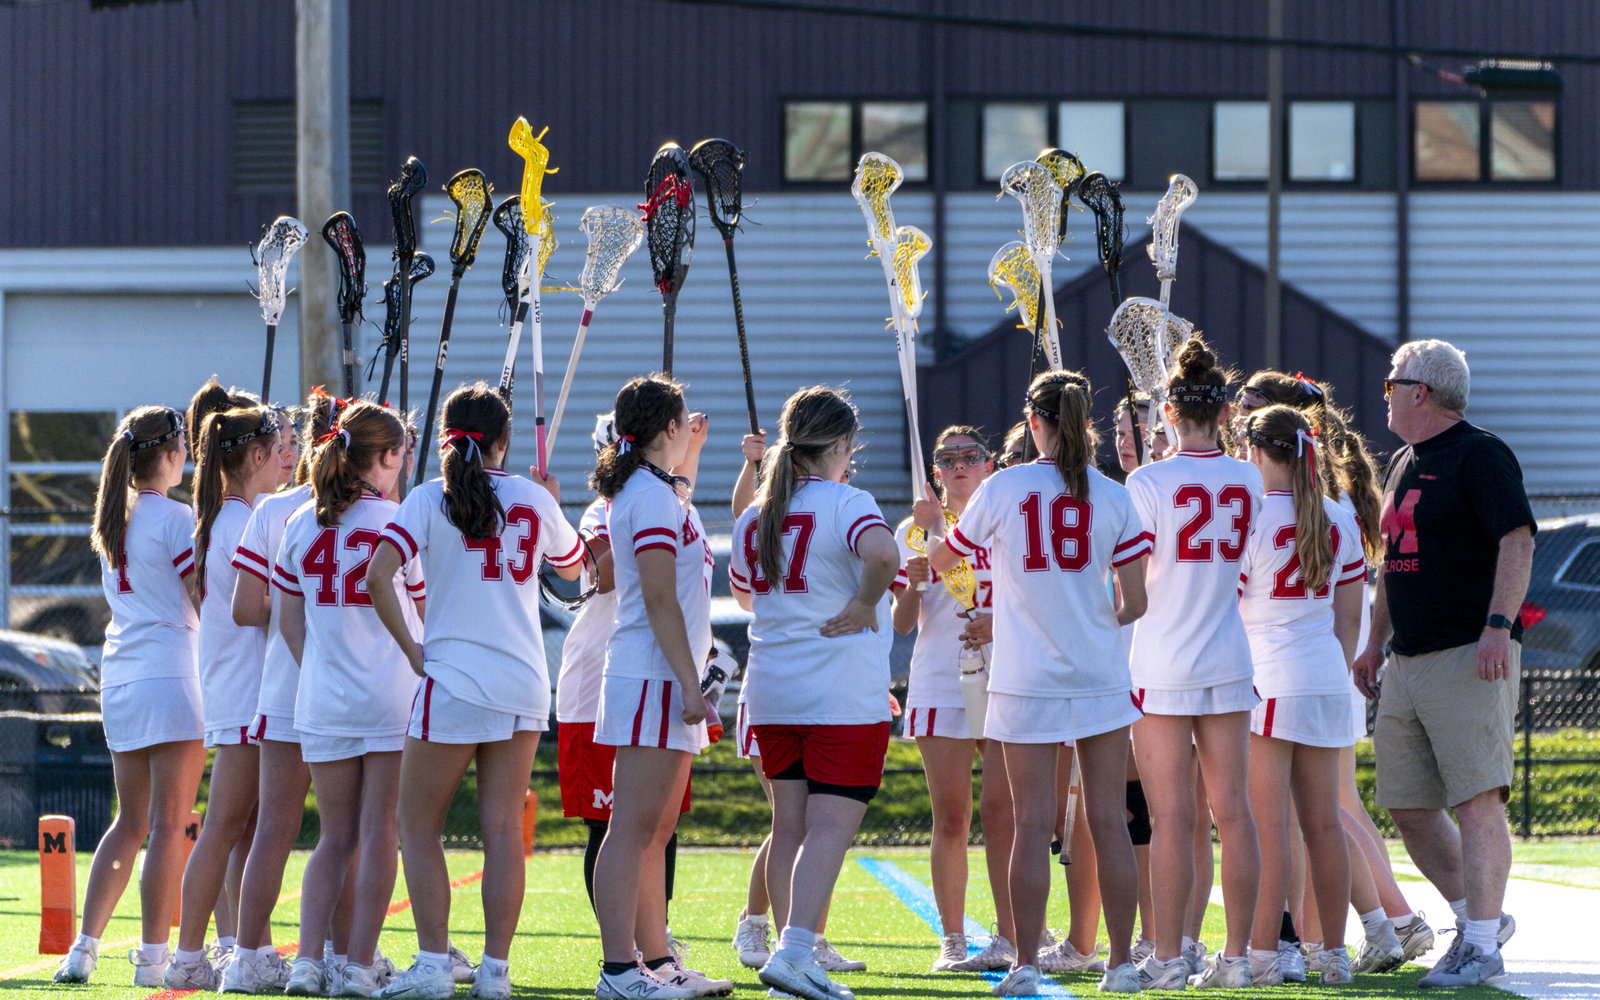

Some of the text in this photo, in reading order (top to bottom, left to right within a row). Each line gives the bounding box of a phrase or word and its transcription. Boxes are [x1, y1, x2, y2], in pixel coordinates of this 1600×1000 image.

[138, 438, 161, 449] STX
[1019, 491, 1094, 573] 18
[1173, 483, 1253, 563] 23
[1380, 488, 1422, 554] M
[300, 526, 381, 607] 42
[972, 580, 993, 608] 7
[592, 789, 615, 810] M
[42, 832, 67, 854] M
